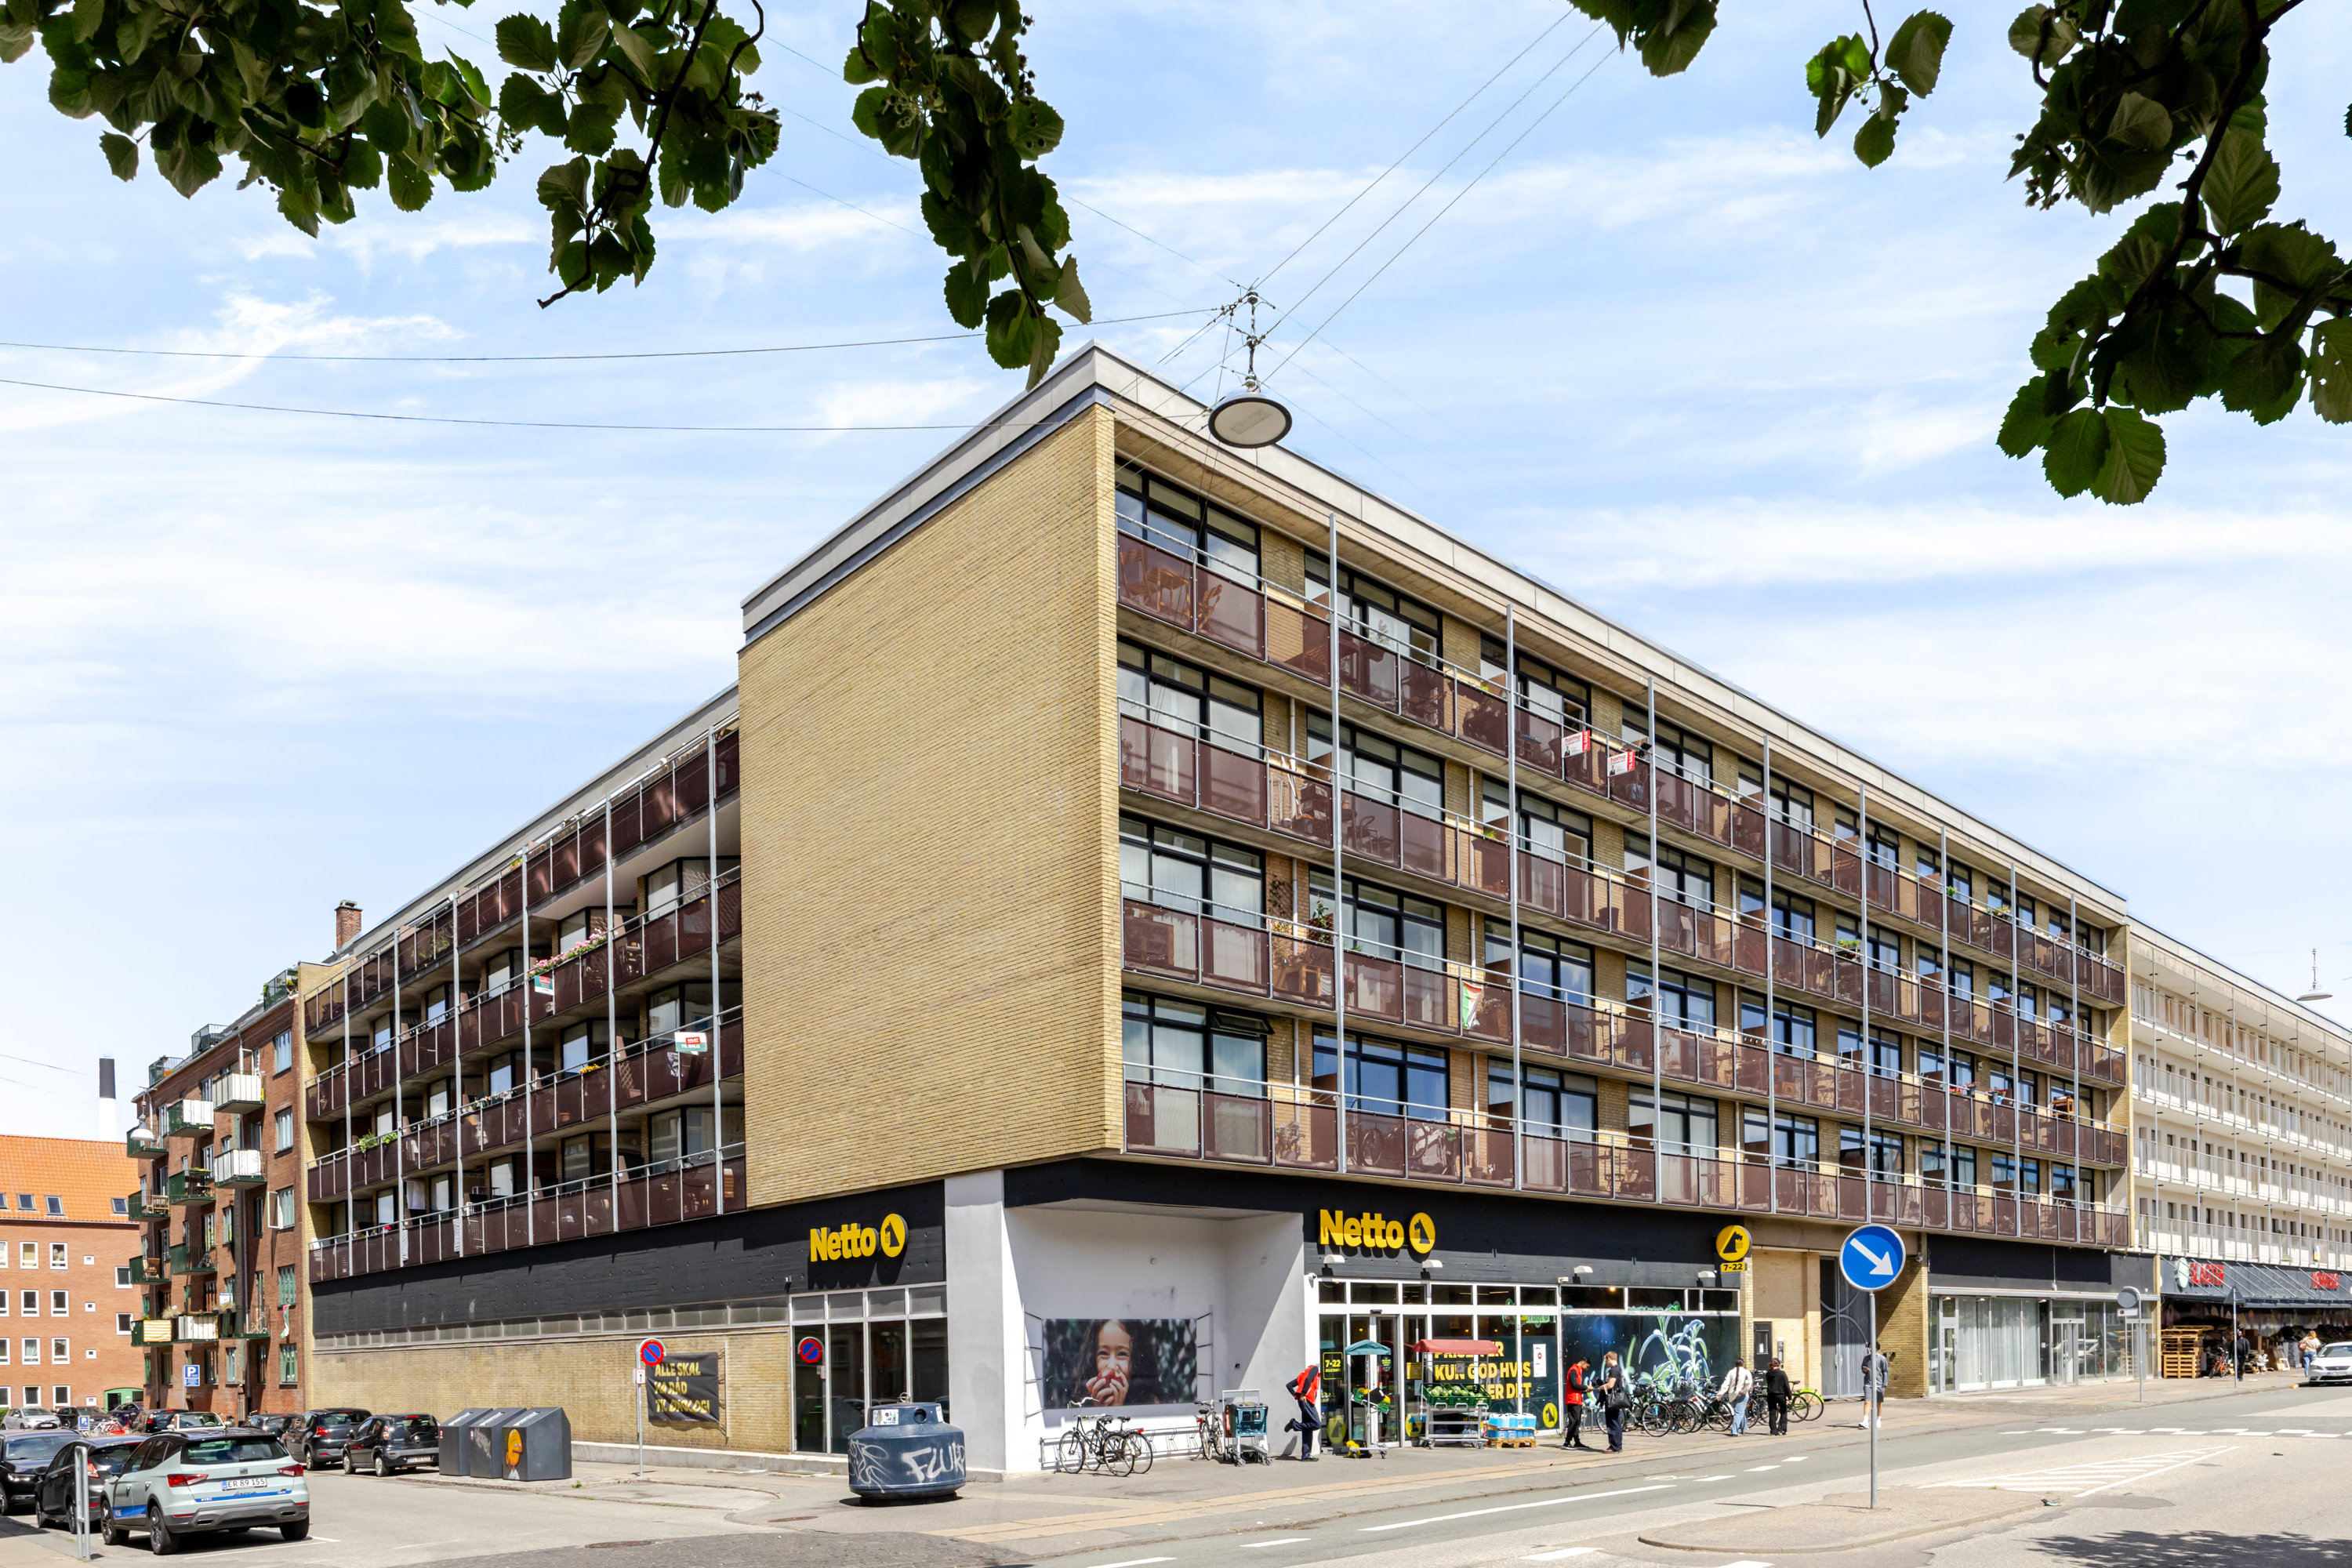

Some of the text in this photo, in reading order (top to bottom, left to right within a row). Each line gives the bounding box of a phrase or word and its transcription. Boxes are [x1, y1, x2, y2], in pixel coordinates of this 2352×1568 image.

[1610, 754, 1626, 763] home
[1319, 1209, 1404, 1248] Netto
[810, 1223, 878, 1261] Netto
[187, 1367, 196, 1377] P
[655, 1363, 701, 1377] ALLE SKAL
[1467, 1363, 1497, 1380] GOD
[1500, 1361, 1531, 1377] HVS
